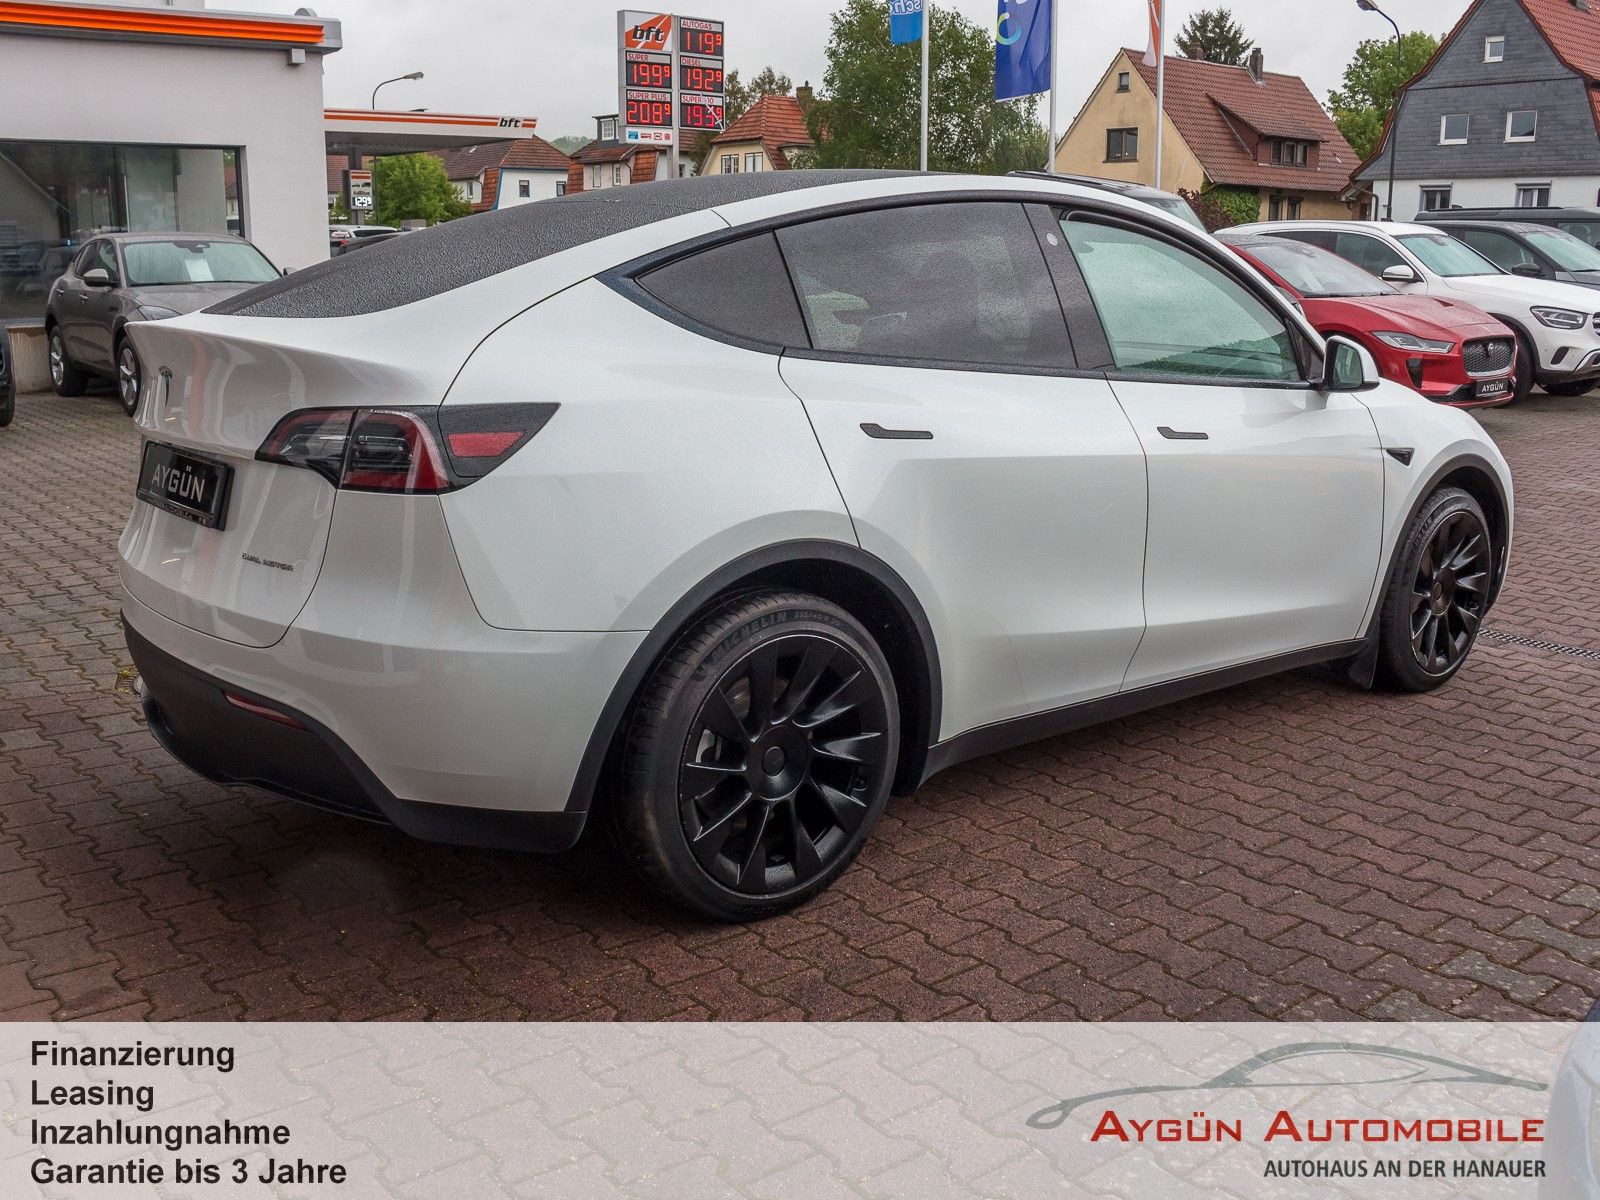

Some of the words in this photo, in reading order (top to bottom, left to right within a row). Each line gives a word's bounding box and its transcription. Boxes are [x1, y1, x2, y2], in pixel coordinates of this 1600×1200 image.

[681, 20, 713, 31] AUTOGAS
[632, 25, 664, 43] bft
[627, 53, 649, 62] SUPER
[681, 58, 702, 67] DIESEL
[628, 91, 650, 100] SUPER
[682, 95, 701, 104] SUPER
[499, 117, 521, 128] bft
[1481, 381, 1505, 394] AYGÜN
[151, 463, 206, 504] AYGÜN
